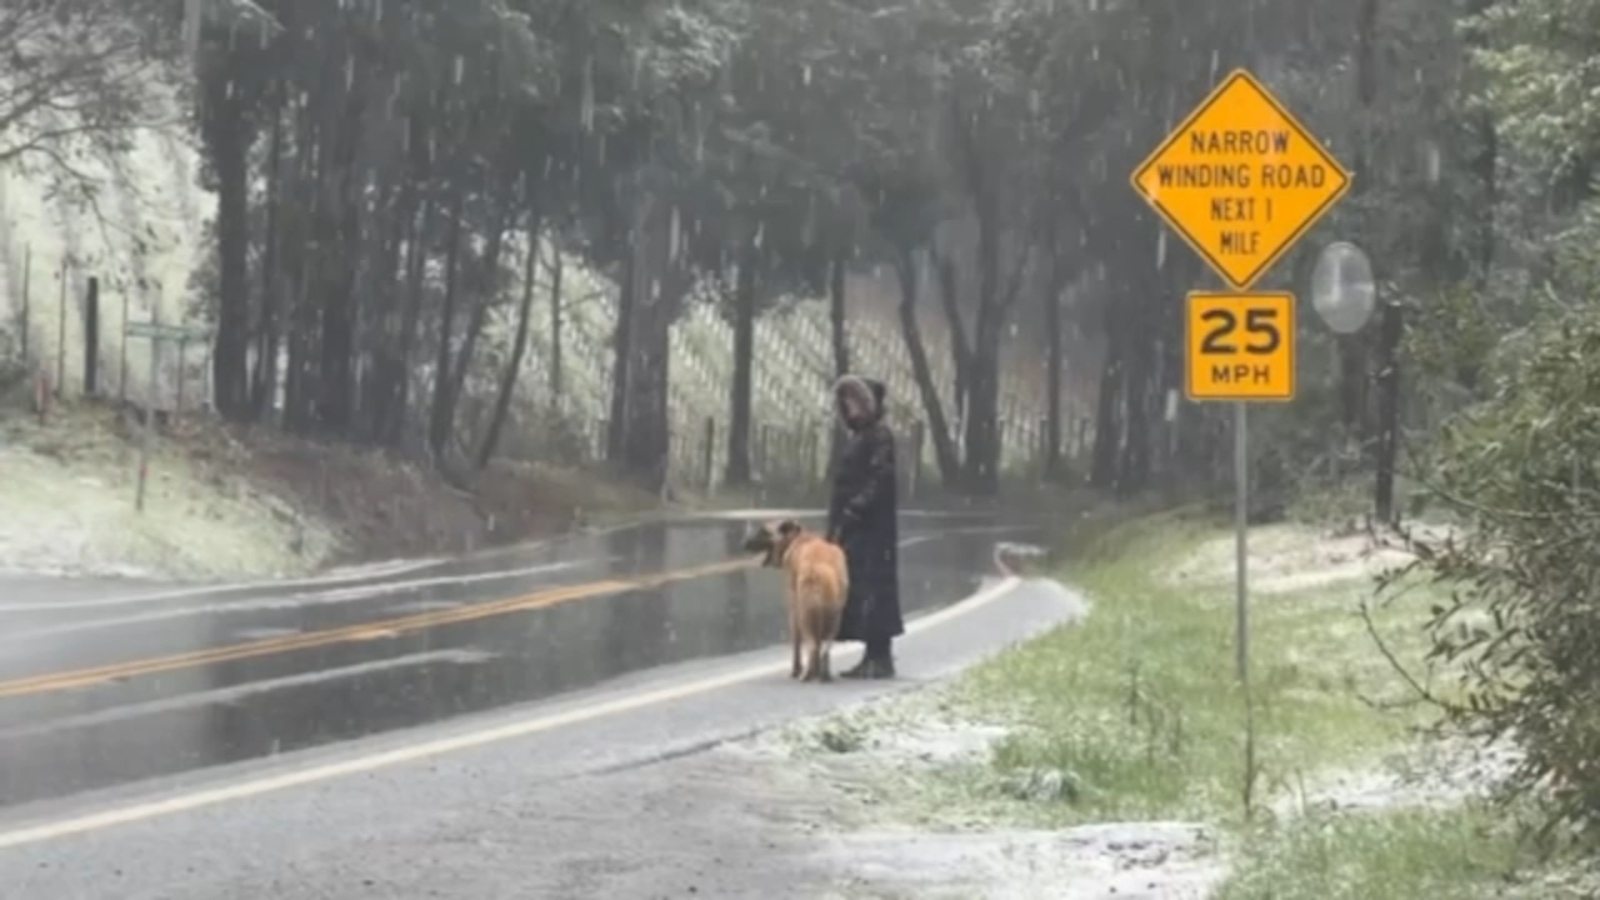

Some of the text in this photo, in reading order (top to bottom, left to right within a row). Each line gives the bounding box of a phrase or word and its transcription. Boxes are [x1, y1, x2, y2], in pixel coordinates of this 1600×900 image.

[1190, 130, 1289, 154] NARROW
[1158, 163, 1325, 188] WINDING ROAD
[1210, 198, 1256, 222] NEXT
[1220, 231, 1261, 256] MILE
[1200, 308, 1280, 356] 25
[1211, 364, 1270, 384] MPH
